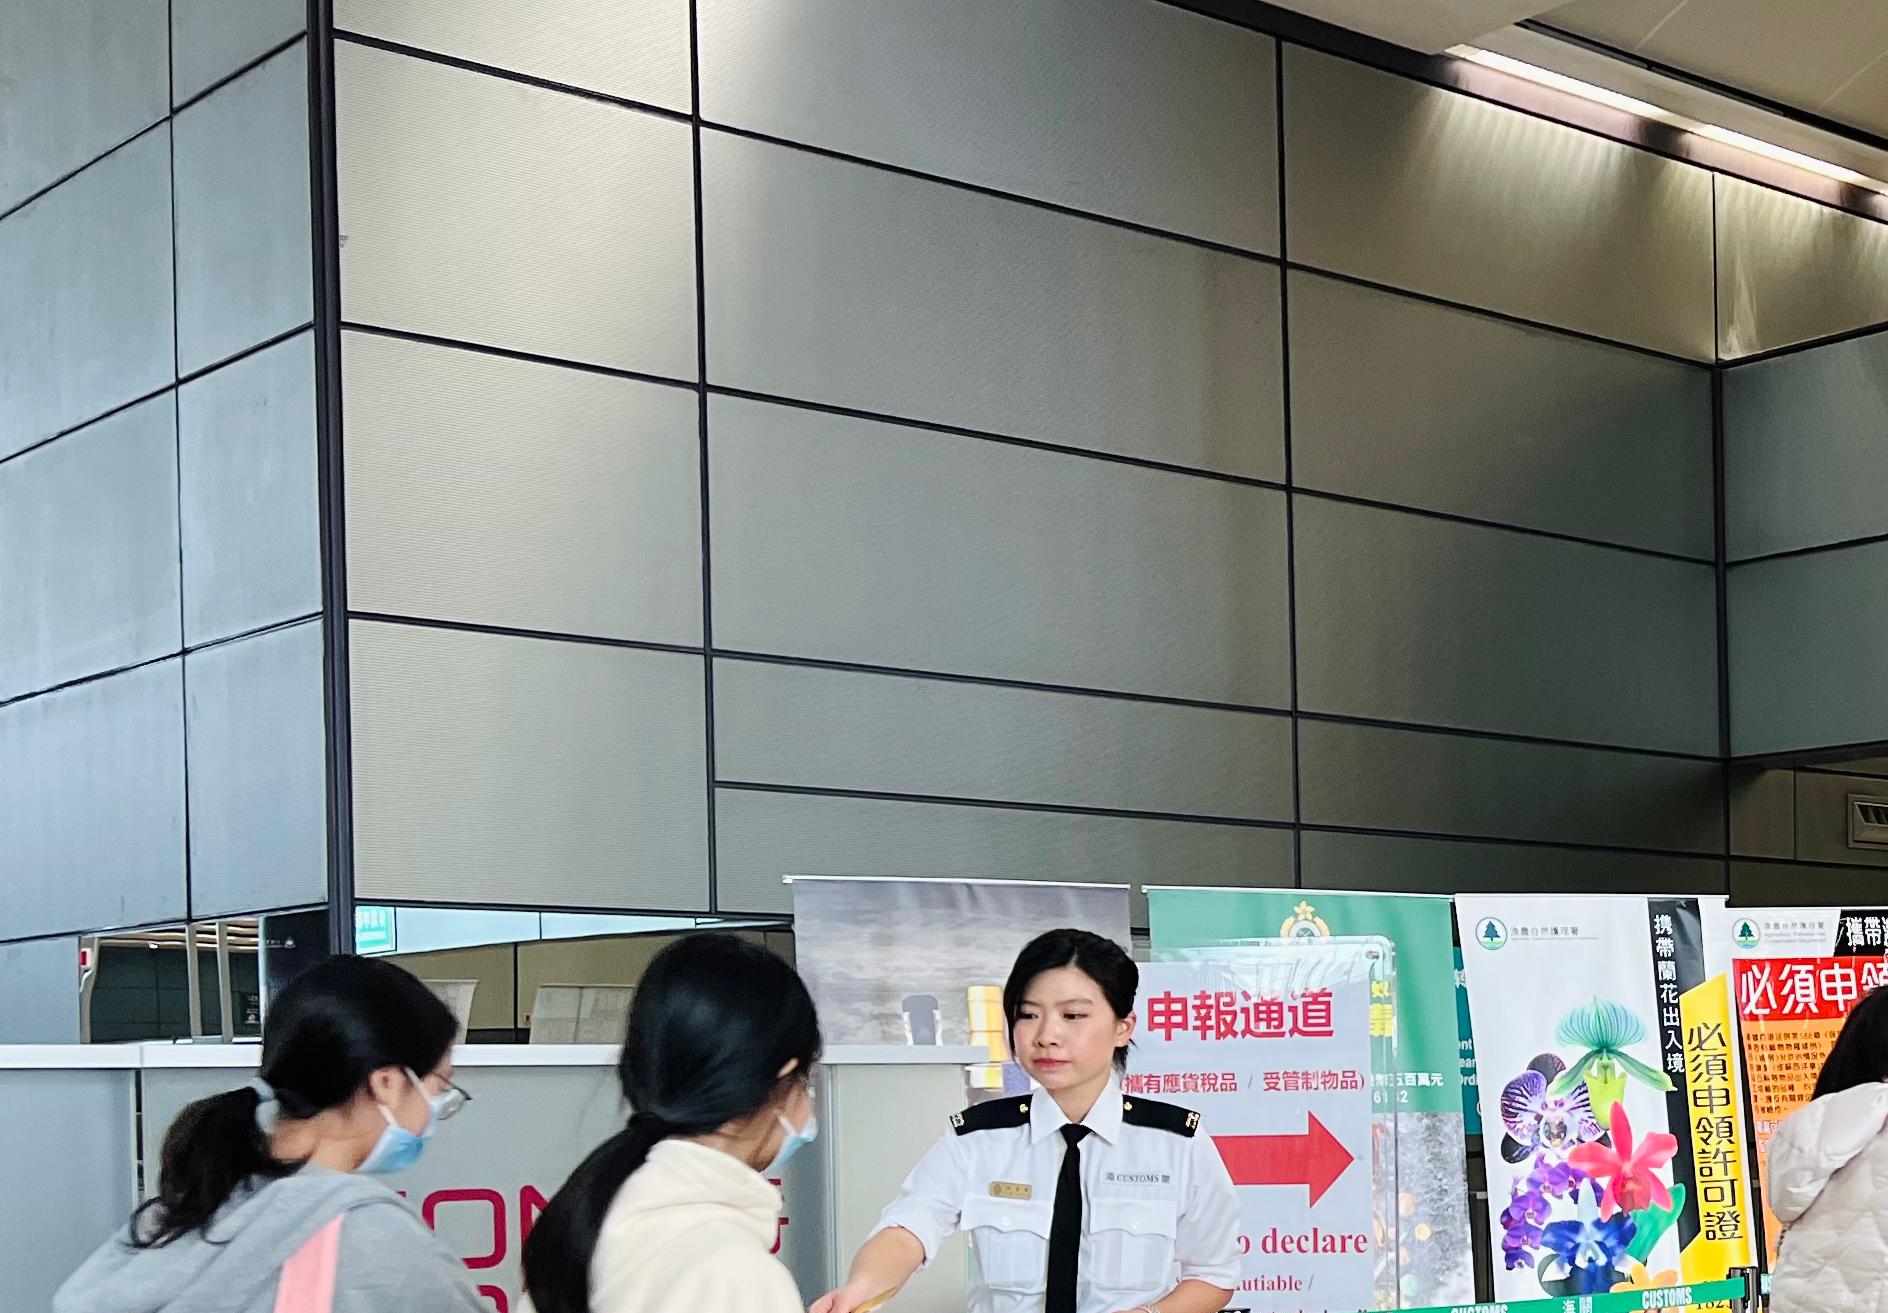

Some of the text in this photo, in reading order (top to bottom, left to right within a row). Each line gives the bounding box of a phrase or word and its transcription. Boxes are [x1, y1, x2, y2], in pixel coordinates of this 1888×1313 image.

[1146, 986, 1335, 1042] 申報通道
[1263, 1069, 1366, 1093] 受管制物品)
[1373, 1089, 1409, 1104] 612
[1686, 1021, 1745, 1242] 必須申領許可證
[1116, 1174, 1160, 1183] CUSTOMS
[1261, 1227, 1369, 1255] declare
[1236, 1275, 1304, 1292] utiable
[1641, 1286, 1693, 1310] CUSTOMS
